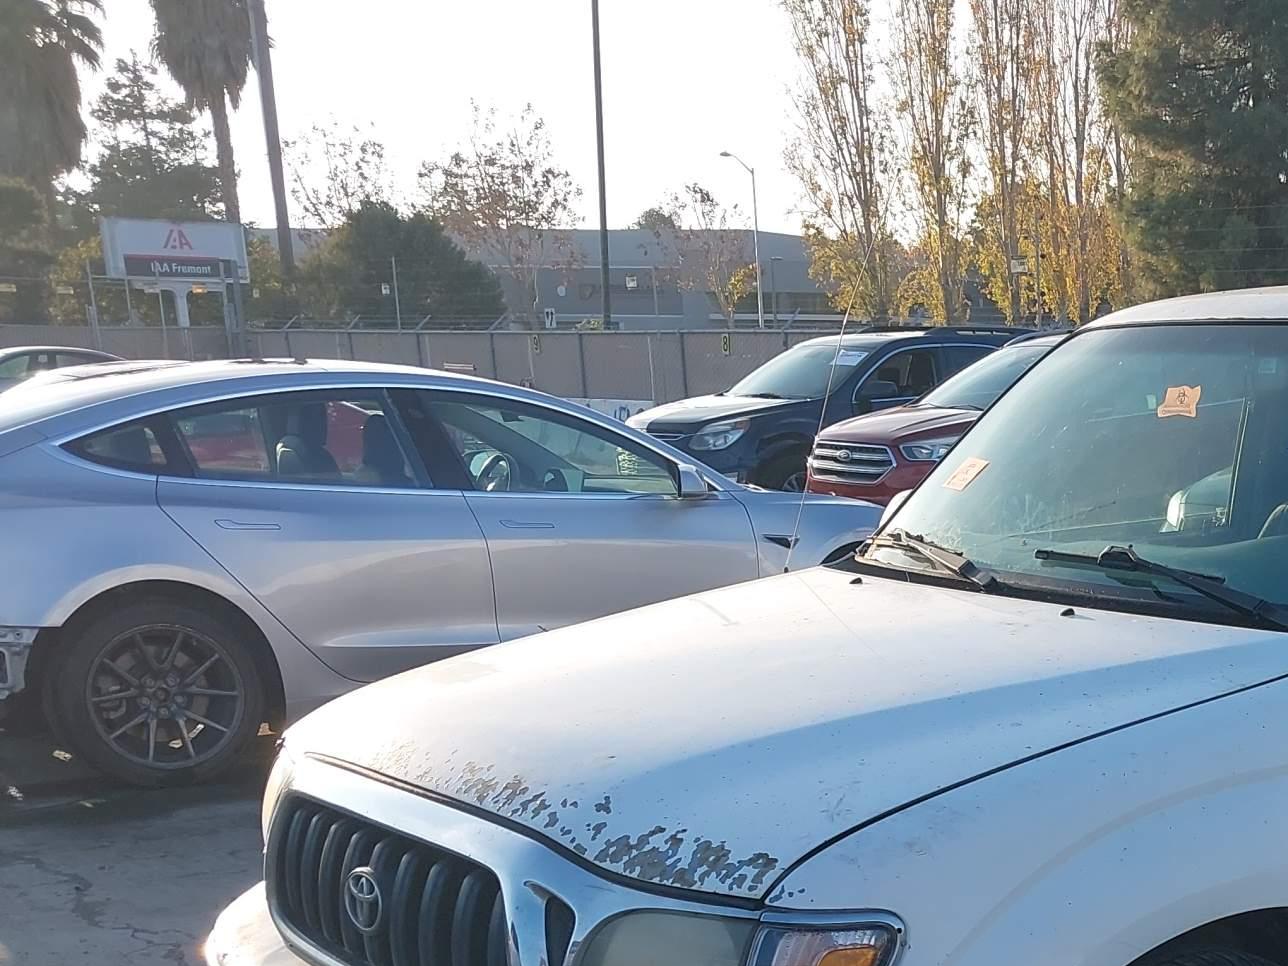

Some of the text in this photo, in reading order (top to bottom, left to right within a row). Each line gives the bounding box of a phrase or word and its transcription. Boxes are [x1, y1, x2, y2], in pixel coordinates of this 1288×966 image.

[151, 262, 211, 274] IAA Fremont
[723, 335, 728, 352] 8
